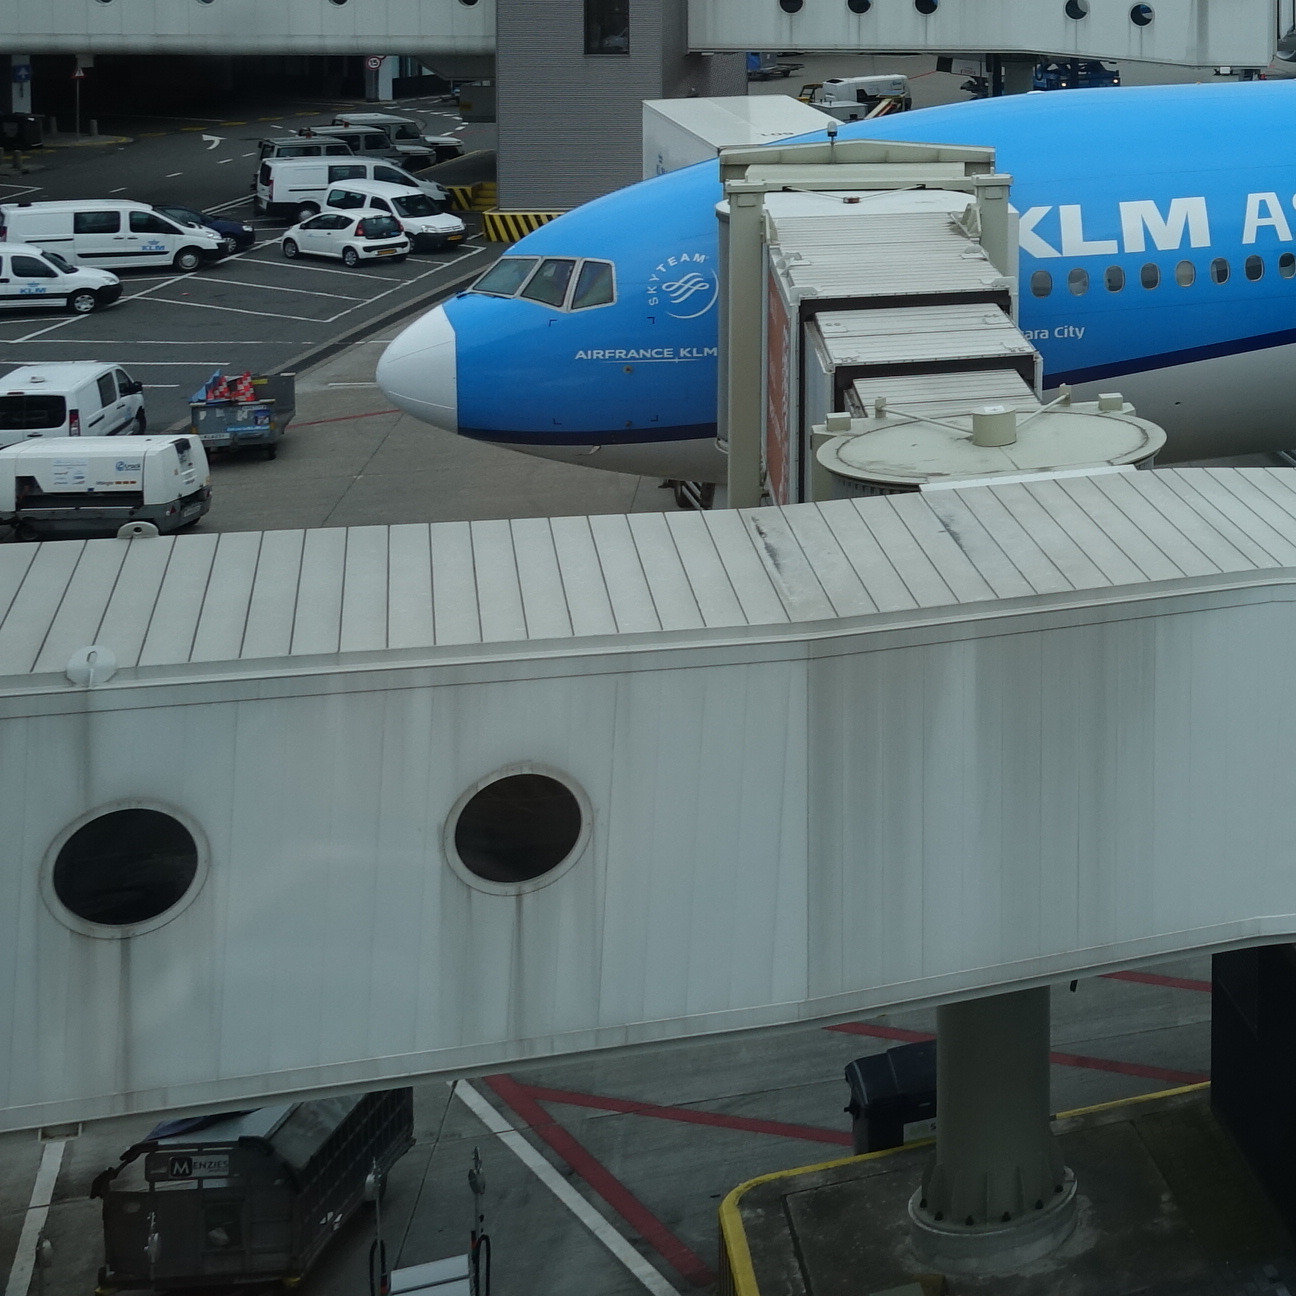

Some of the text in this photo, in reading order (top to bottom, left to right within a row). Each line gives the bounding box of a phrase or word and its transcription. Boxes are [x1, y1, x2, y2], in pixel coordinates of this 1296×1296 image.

[646, 253, 706, 306] SKYTEAM
[20, 287, 47, 295] KLM
[1021, 325, 1085, 340] ara City
[679, 347, 717, 357] KLM
